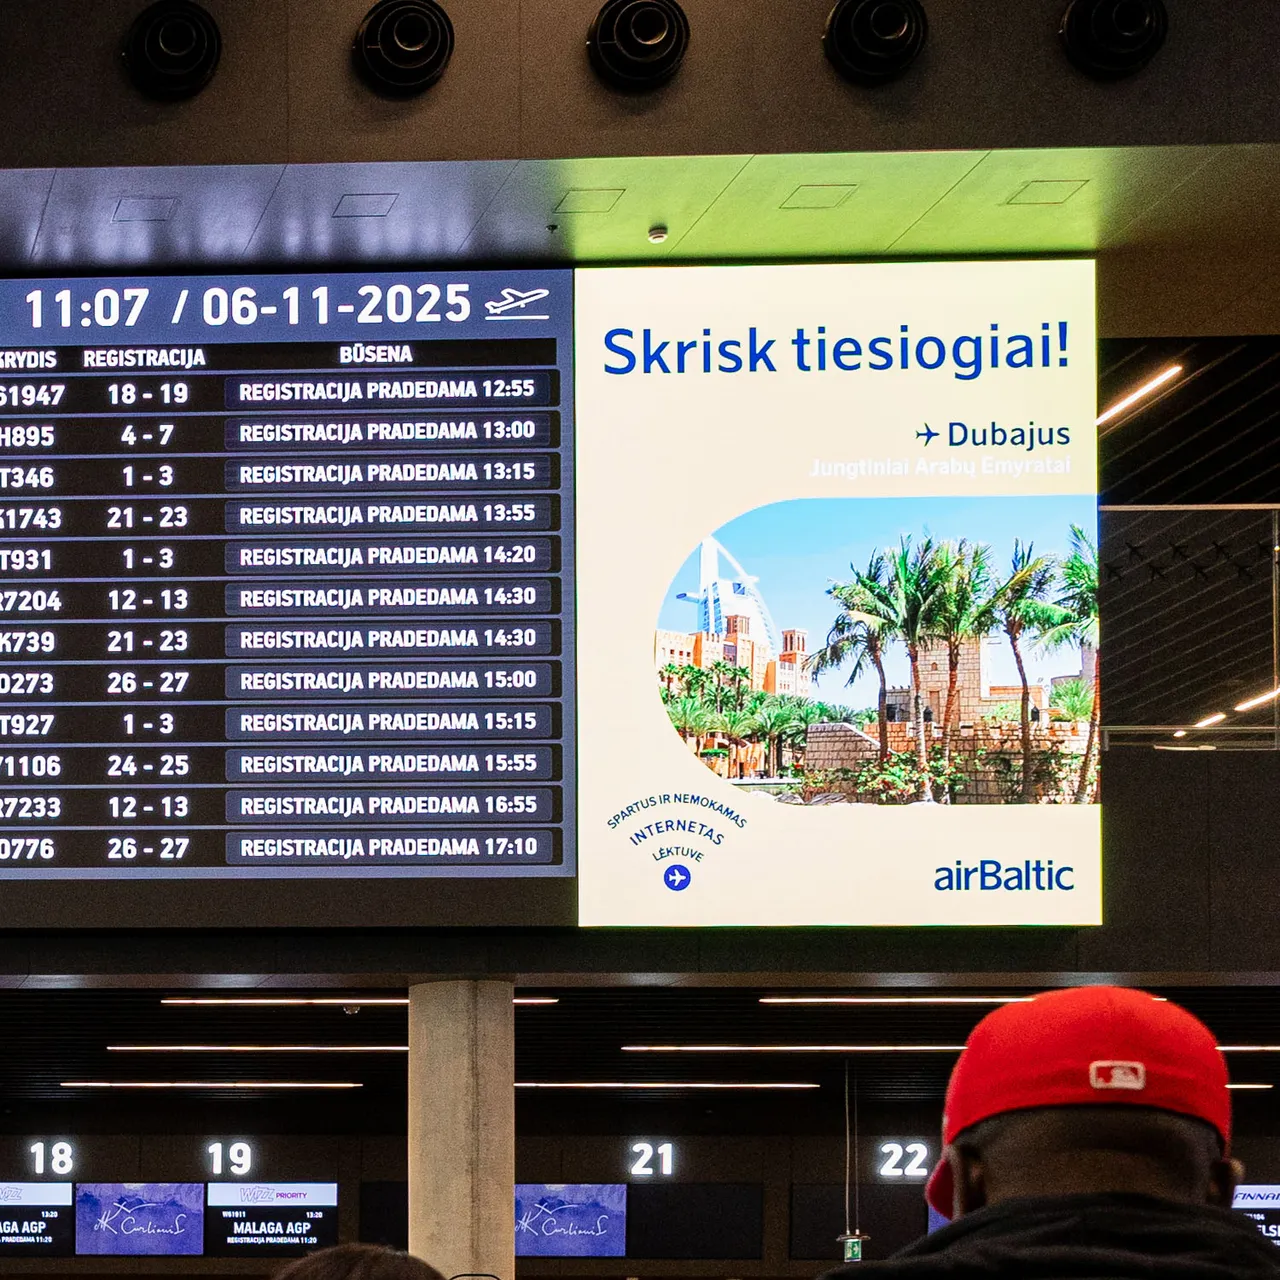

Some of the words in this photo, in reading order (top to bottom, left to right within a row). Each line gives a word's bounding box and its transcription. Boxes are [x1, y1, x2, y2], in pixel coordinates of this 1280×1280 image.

[27, 289, 149, 327] 11:07
[172, 290, 188, 323] /
[204, 284, 470, 325] 06-11-2025
[84, 349, 205, 369] REGISTRACIJA
[340, 343, 413, 363] BŪSENA
[605, 327, 776, 374] Skrisk
[792, 321, 1067, 380] tiesiogiai!
[240, 383, 363, 402] REGISTRACIJA
[367, 381, 477, 398] PRADEDAMA
[483, 380, 534, 396] 12:55
[949, 422, 1070, 451] Dubajus
[607, 796, 657, 829] SPARTUS
[659, 793, 671, 804] IR
[674, 793, 747, 828] NEMOKAMAS
[629, 819, 725, 846] INTERNETAS
[652, 845, 704, 862] LĖKTUVE
[935, 860, 1074, 890] airBaltic
[30, 1141, 74, 1175] 18
[208, 1142, 252, 1176] 19
[630, 1142, 673, 1175] 21
[879, 1142, 928, 1177] 22
[275, 1191, 308, 1200] PRIORITY
[22, 1222, 46, 1233] AGP
[234, 1222, 283, 1234] MALAGA
[286, 1222, 311, 1233] AGP
